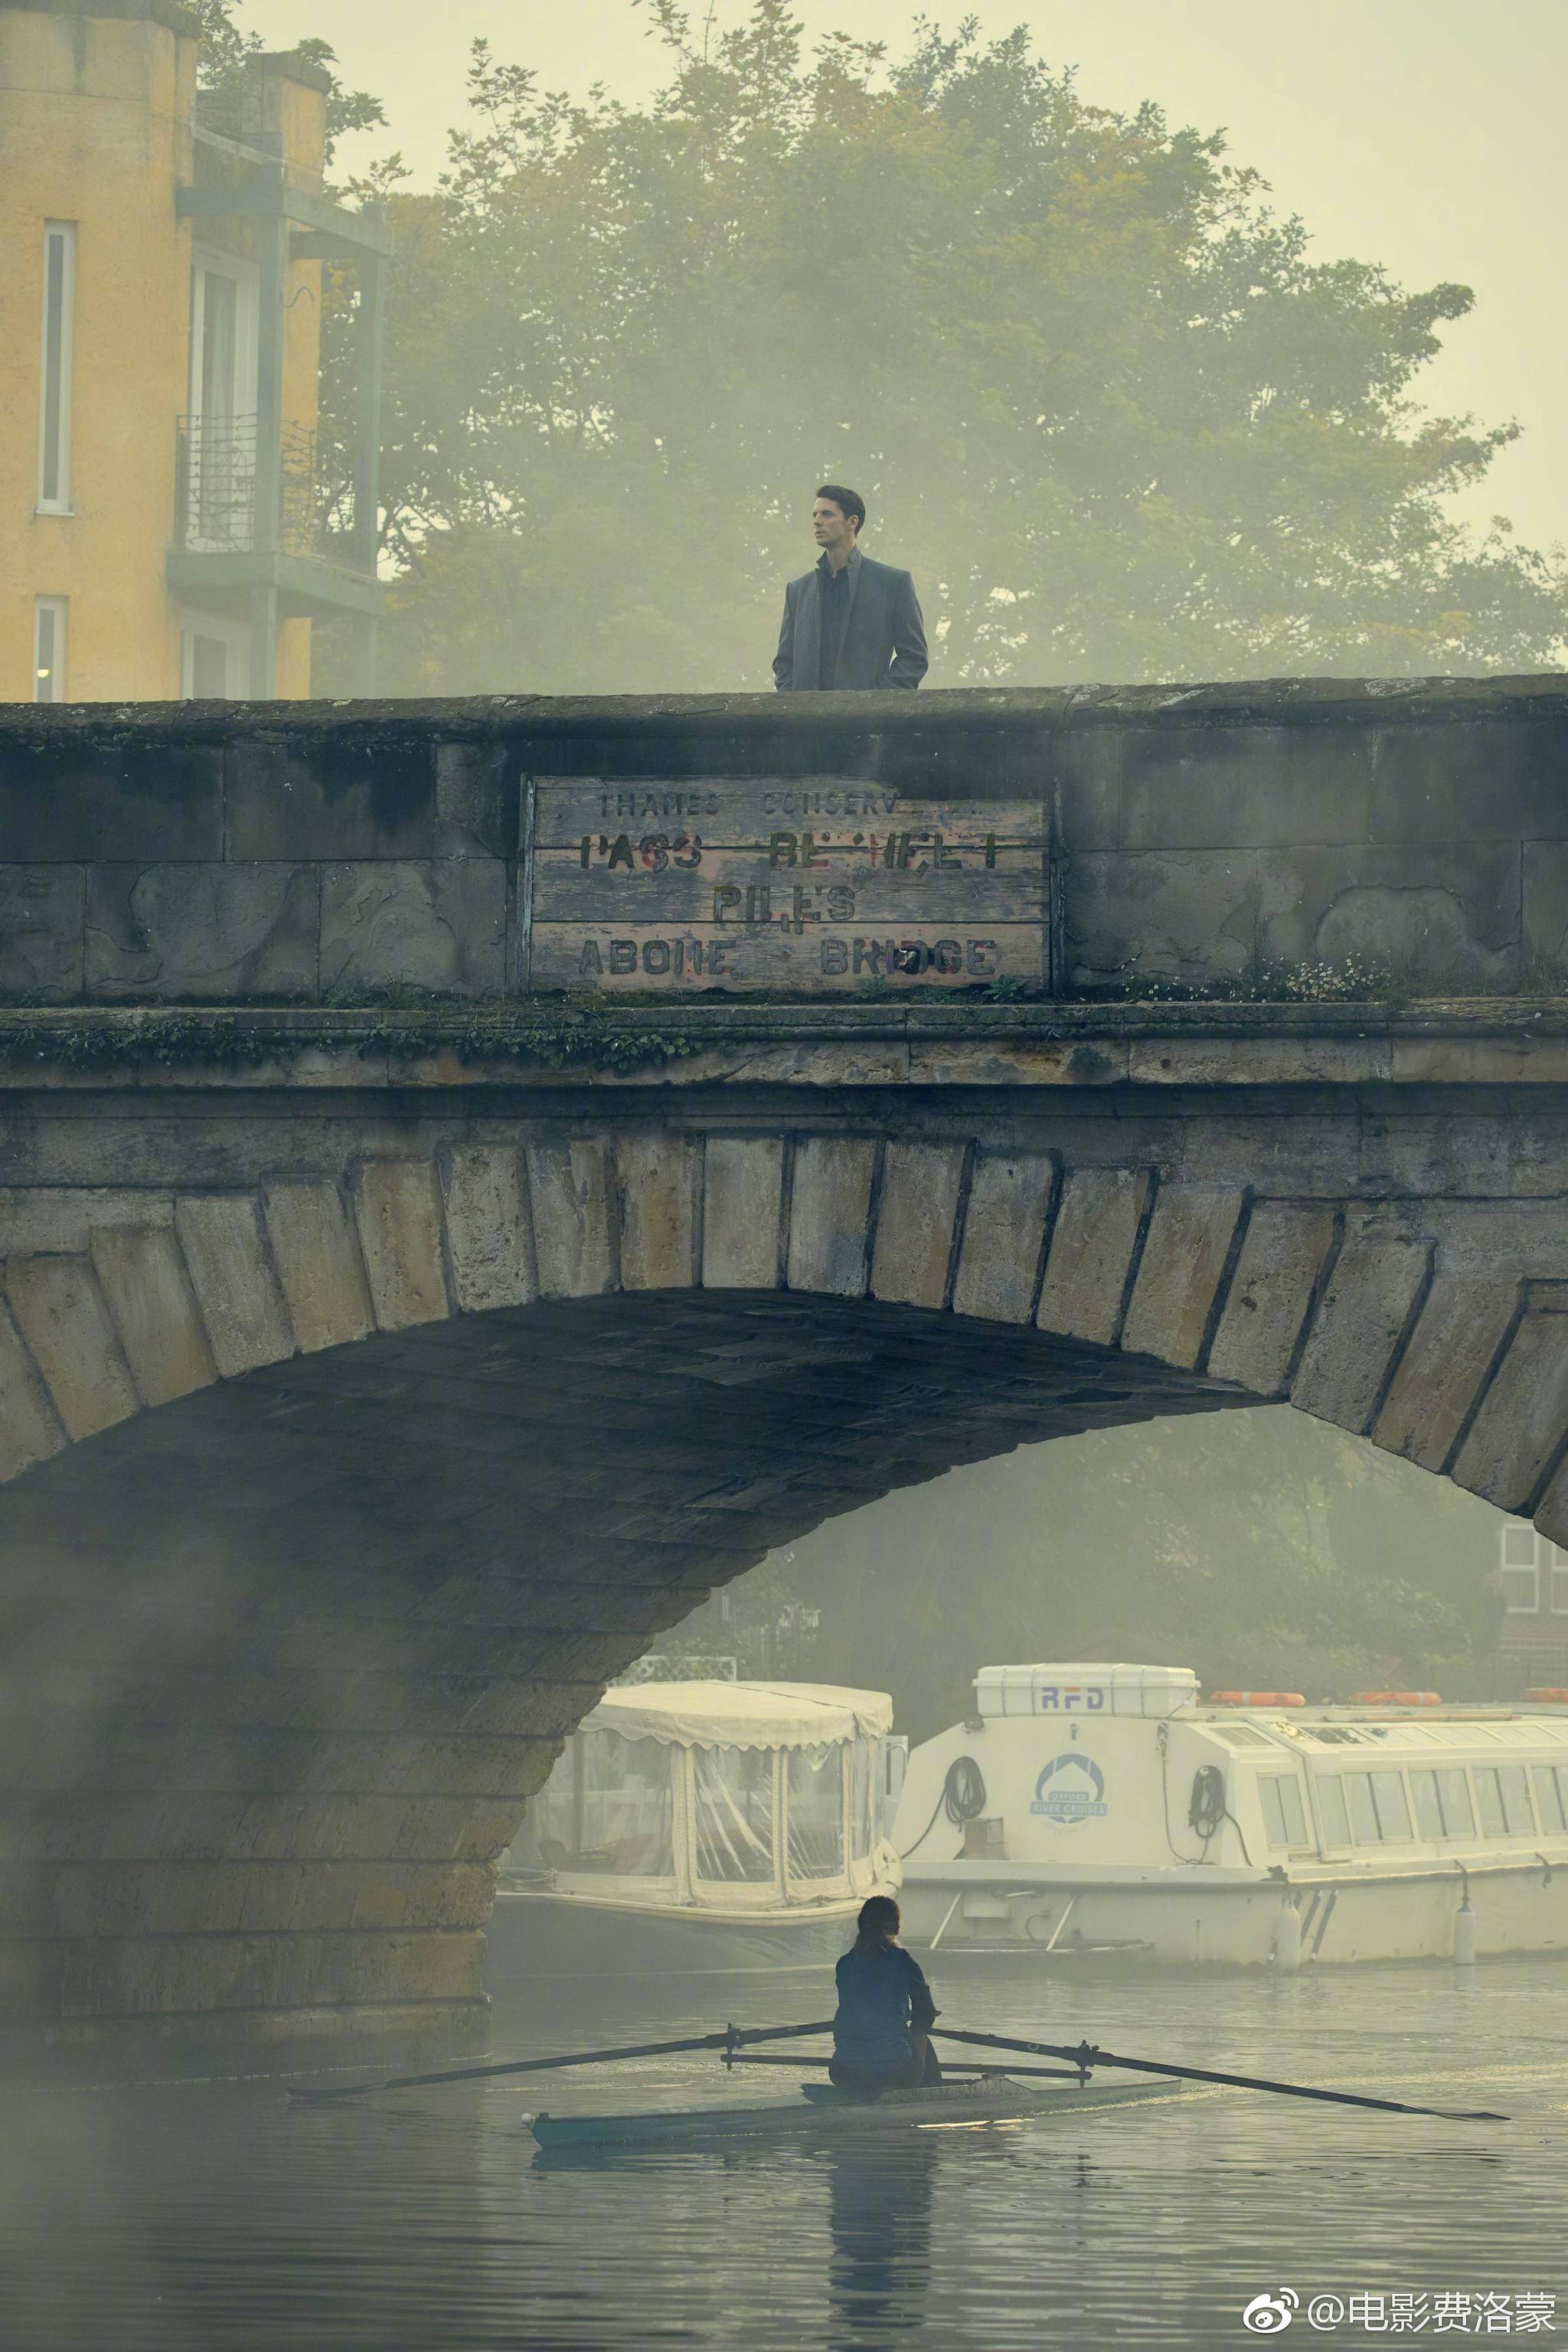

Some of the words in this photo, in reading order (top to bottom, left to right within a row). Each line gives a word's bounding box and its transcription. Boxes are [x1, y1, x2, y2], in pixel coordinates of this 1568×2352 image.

[599, 792, 720, 816] THAMES
[580, 831, 704, 874] PASS
[713, 884, 856, 922] PILES
[820, 937, 996, 976] BRIDGE
[1041, 1687, 1104, 1710] RFD
[1033, 1803, 1061, 1814] RIVER
[1063, 1804, 1105, 1815] CRUISES
